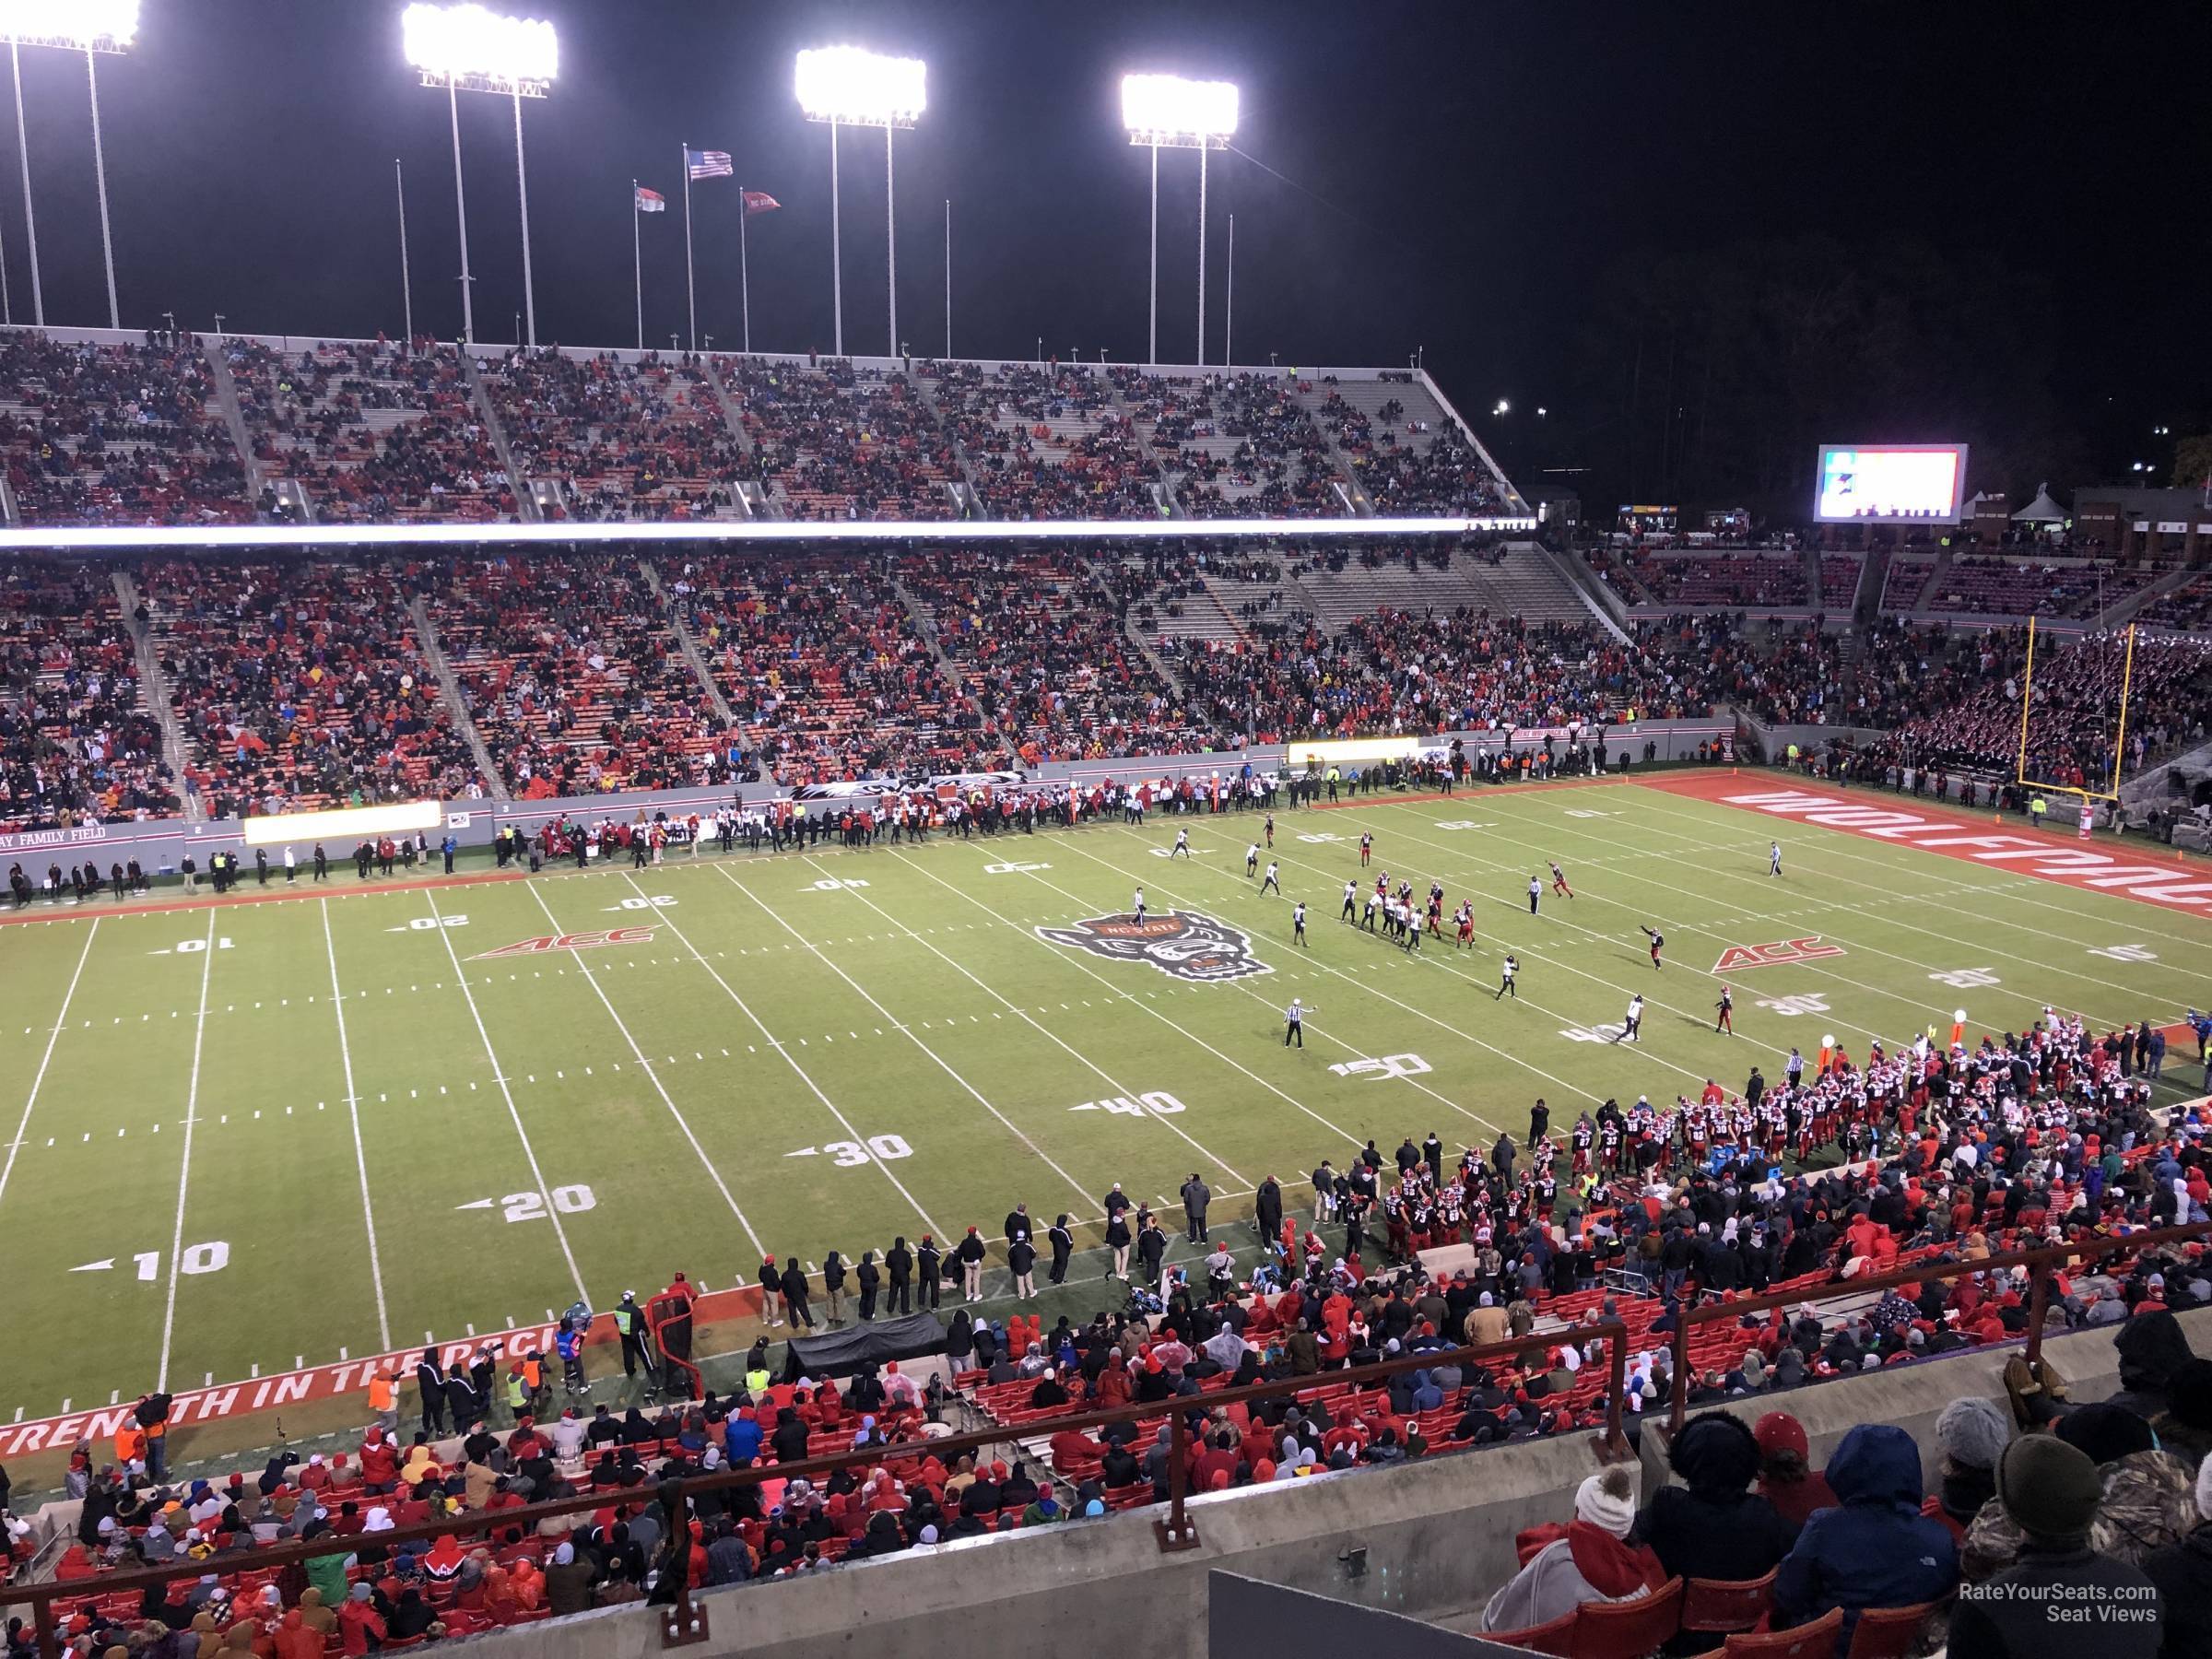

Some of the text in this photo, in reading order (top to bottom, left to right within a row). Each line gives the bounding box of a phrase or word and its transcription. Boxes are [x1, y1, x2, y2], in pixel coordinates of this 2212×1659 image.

[19, 831, 65, 846] FAMILY
[71, 828, 106, 841] FIELD
[194, 826, 202, 834] 2
[410, 914, 470, 930] 20
[1135, 924, 1178, 934] STATE
[177, 936, 237, 954] 10
[464, 924, 664, 961] ACC
[1711, 935, 1848, 973] ACC
[1928, 969, 2002, 989] 20
[1755, 994, 1831, 1017] 30
[1099, 1090, 1186, 1118] 40
[823, 1134, 914, 1167] 30
[1579, 1137, 1591, 1147] 27
[1467, 1163, 1479, 1175] 70
[500, 1183, 597, 1224] 20
[1385, 1203, 1397, 1216] 72
[133, 1241, 230, 1281] 10
[252, 1367, 312, 1408] IN
[331, 1357, 423, 1394] THE
